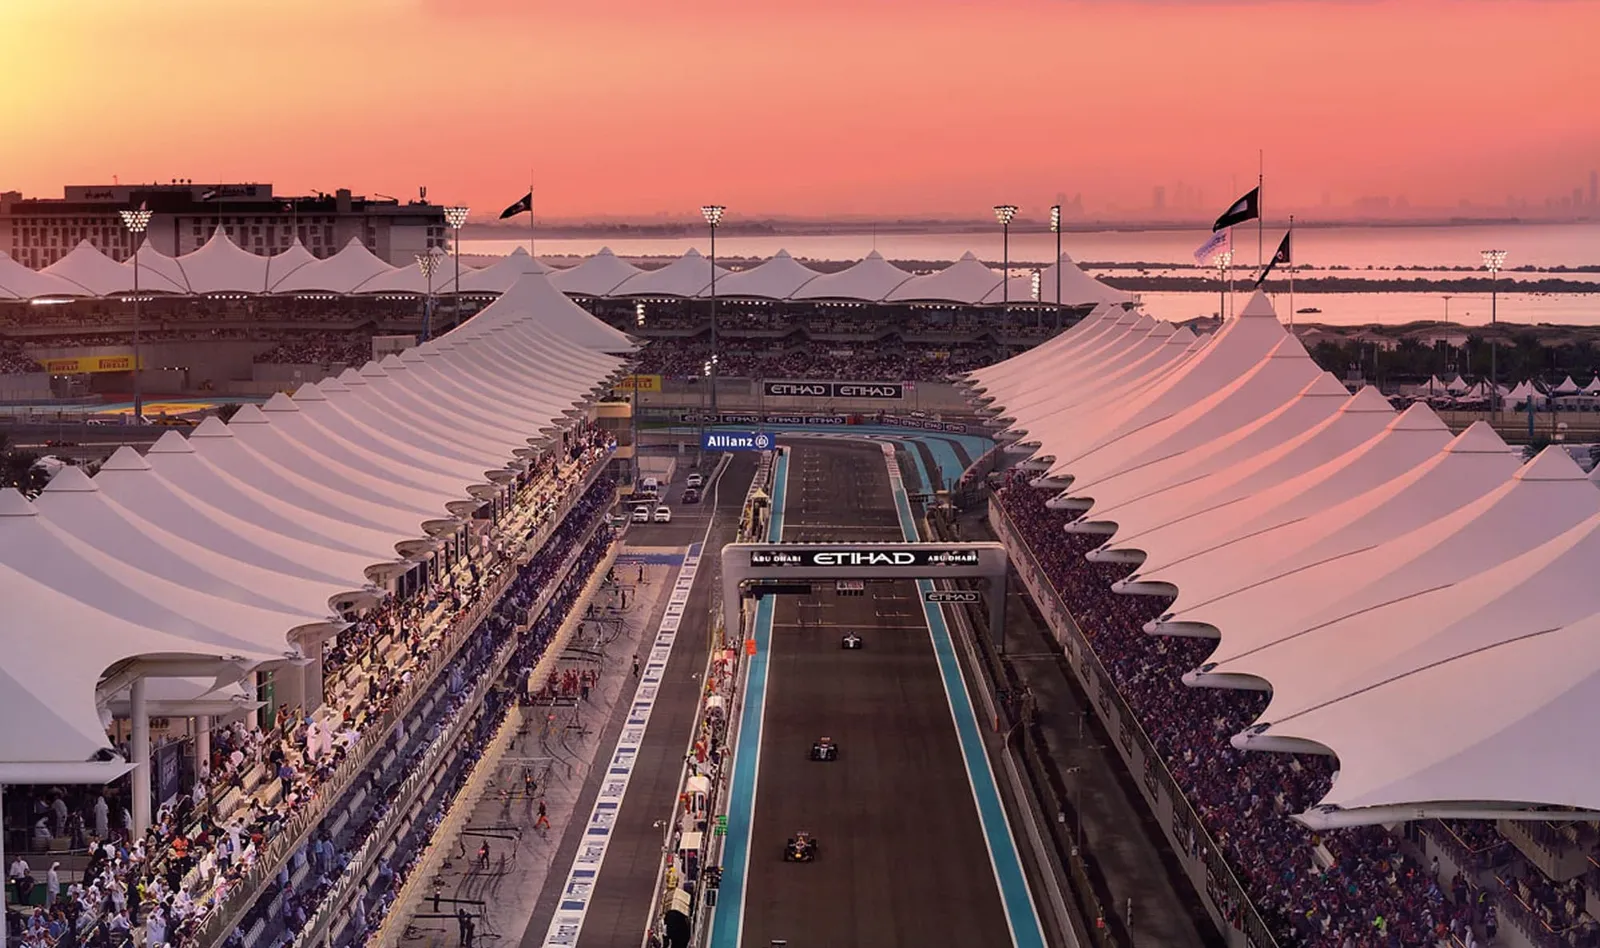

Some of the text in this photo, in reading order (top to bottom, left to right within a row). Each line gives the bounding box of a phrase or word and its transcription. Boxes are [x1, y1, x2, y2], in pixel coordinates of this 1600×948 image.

[771, 384, 826, 395] ETIHAD
[840, 386, 896, 396] ETIHAD
[707, 435, 753, 447] Allianz
[813, 552, 916, 565] ETIHAD
[928, 593, 977, 601] ETIHAD
